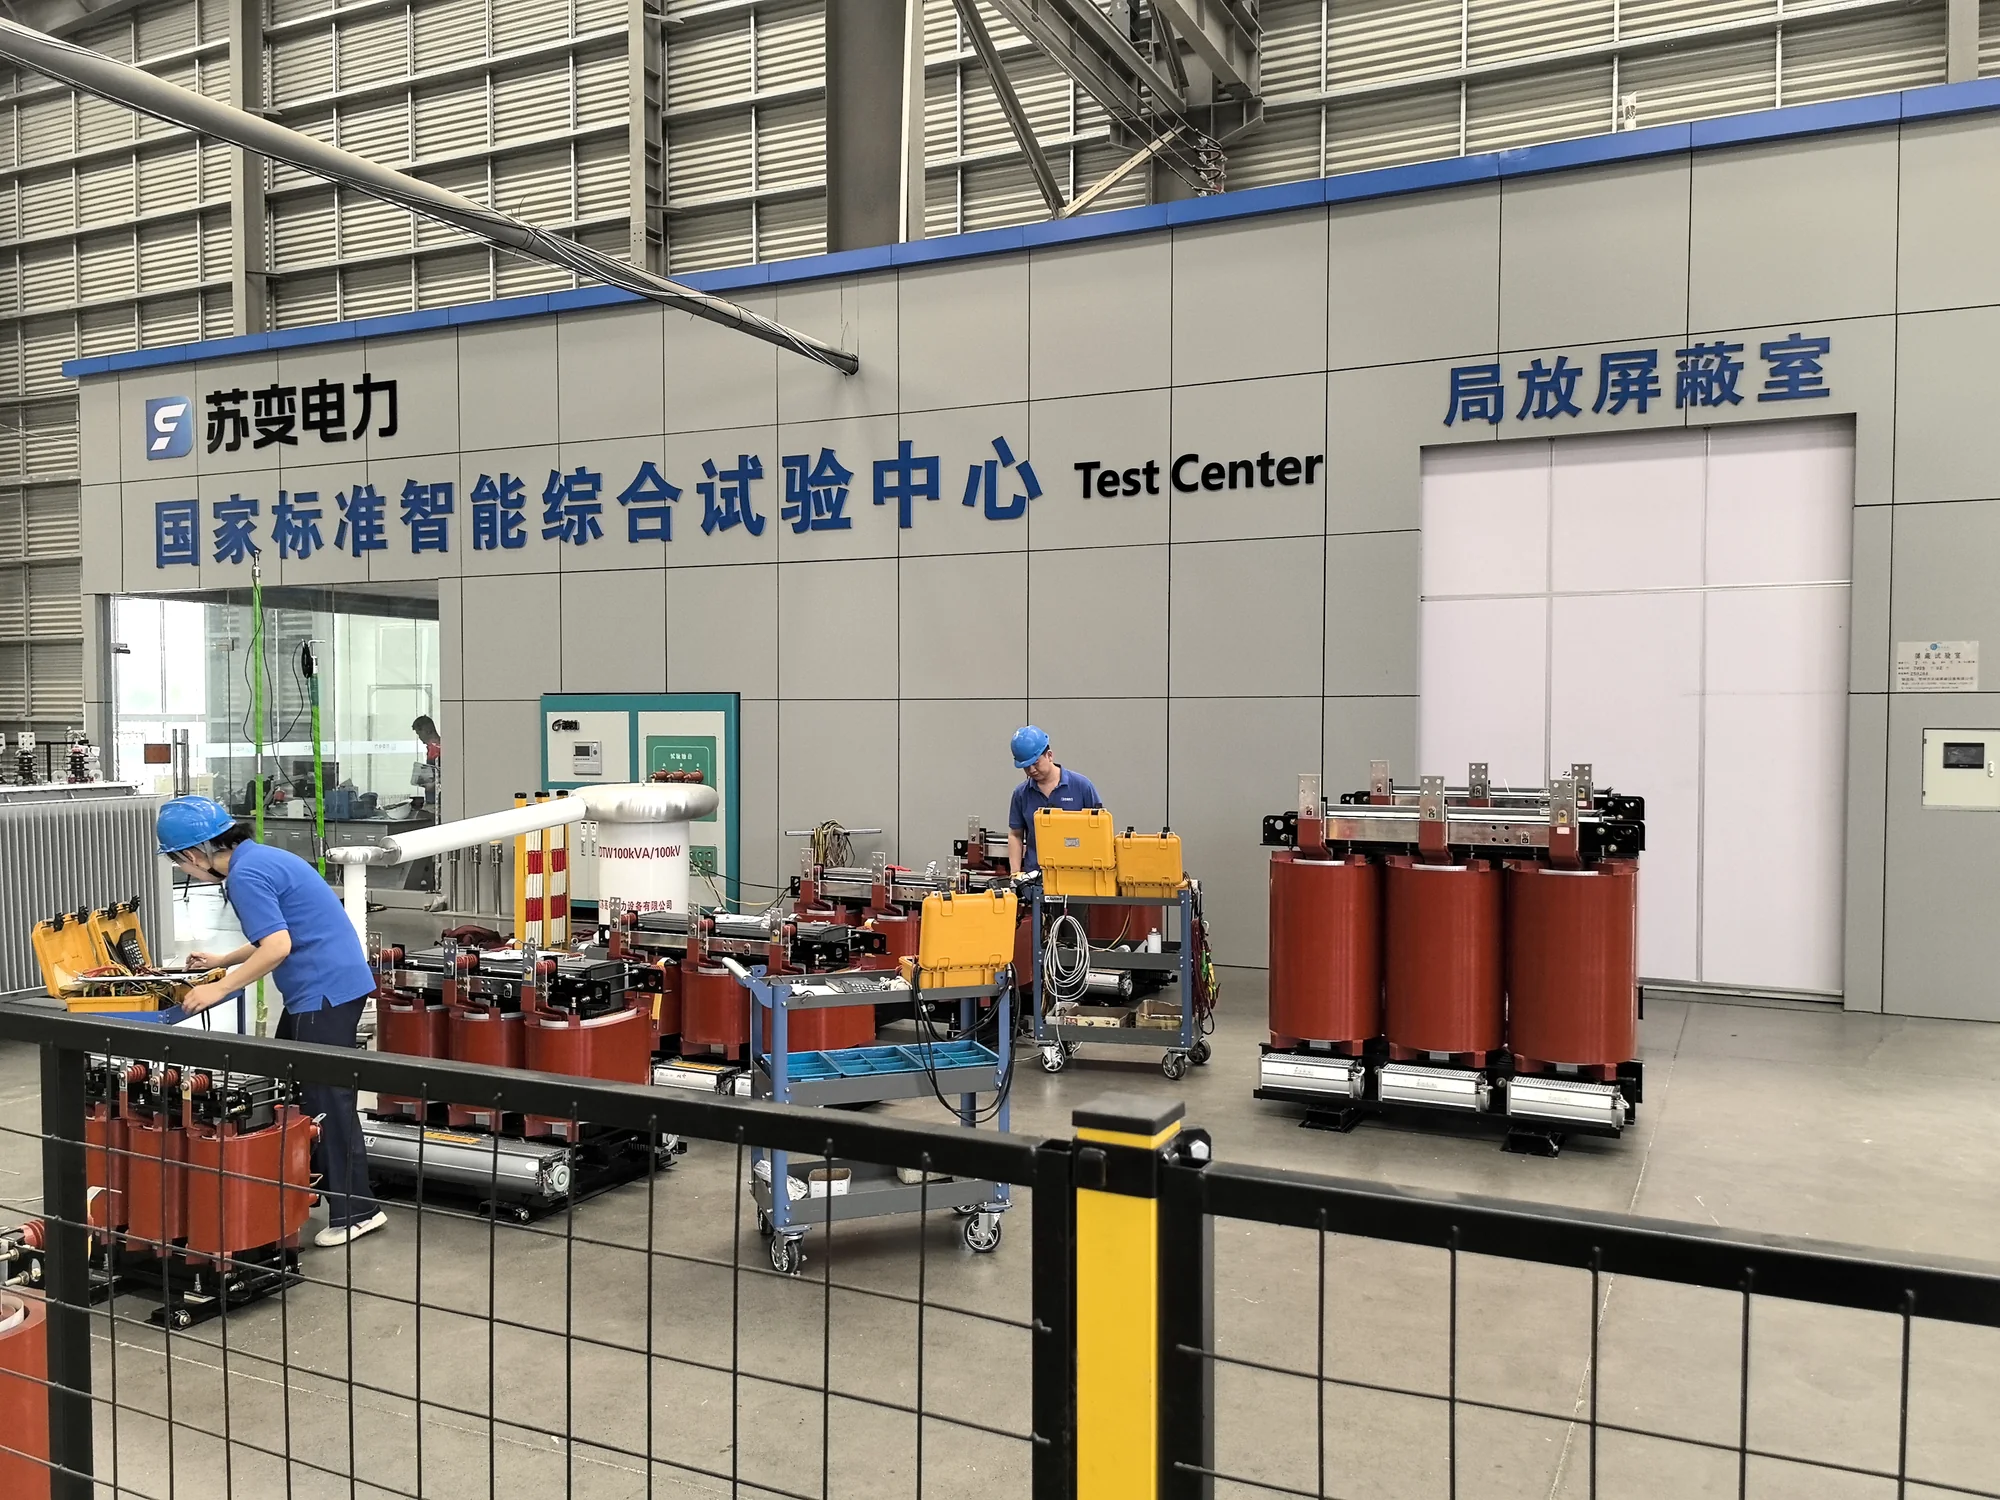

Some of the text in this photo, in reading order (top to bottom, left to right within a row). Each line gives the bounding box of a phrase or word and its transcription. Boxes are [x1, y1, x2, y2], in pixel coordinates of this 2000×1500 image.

[205, 372, 398, 454] 苏变电力
[1443, 332, 1831, 427] 局放屏蔽室
[155, 436, 1044, 568] 国家标准智能综合试验中心
[1074, 451, 1325, 499] Test Center
